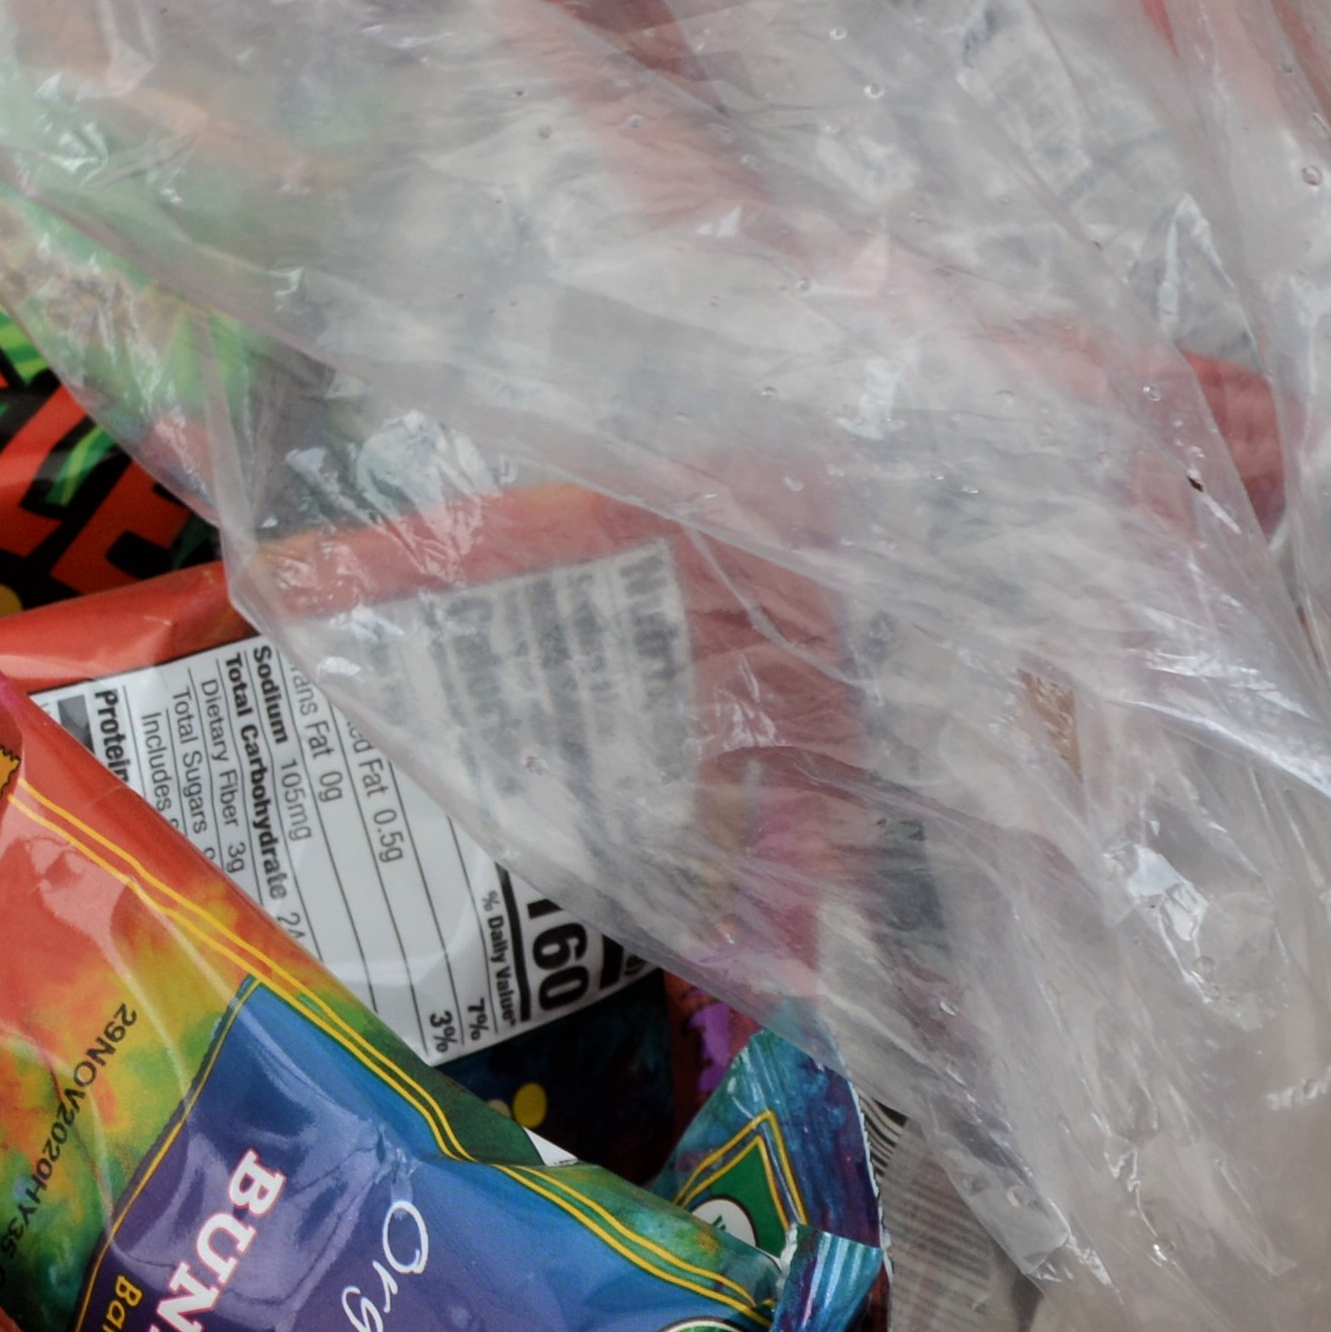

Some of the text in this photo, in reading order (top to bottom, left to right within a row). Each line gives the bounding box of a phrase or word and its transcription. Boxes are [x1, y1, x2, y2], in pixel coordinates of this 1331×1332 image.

[140, 712, 173, 812] Includes
[173, 687, 209, 835] Total Sugars
[201, 679, 238, 827] Dietary Fiber
[225, 653, 288, 901] Total Carbohydrate
[253, 645, 314, 843] Sodium 105mg
[304, 720, 343, 803] Fat 0g
[359, 757, 390, 798] Fat
[373, 808, 404, 864] 0.5g
[430, 1011, 458, 1055] 3%
[468, 997, 490, 1041] 7%
